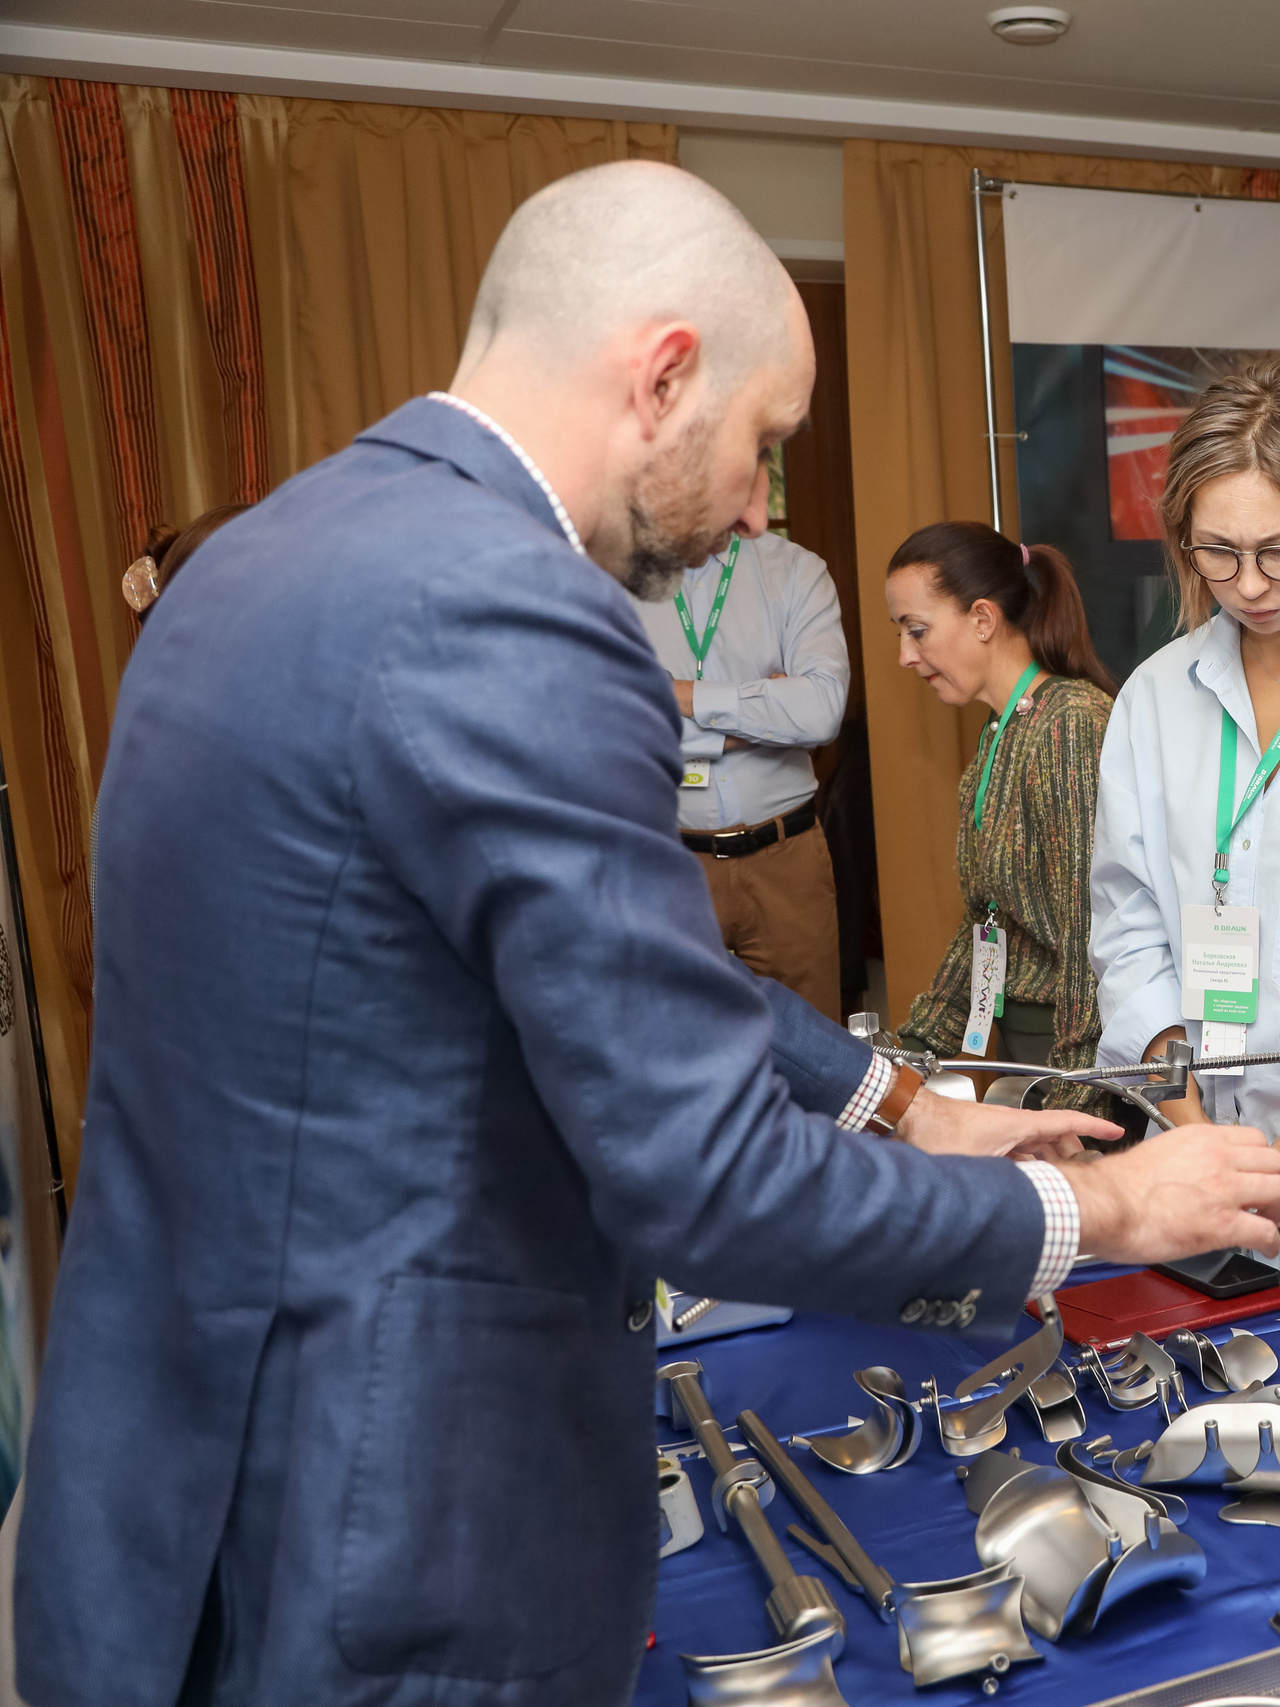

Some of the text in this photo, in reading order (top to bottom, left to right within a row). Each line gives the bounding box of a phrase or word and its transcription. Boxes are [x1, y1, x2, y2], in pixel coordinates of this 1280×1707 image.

[1247, 775, 1263, 800] BRAUN
[1216, 960, 1247, 968] Андреевна
[972, 1035, 979, 1046] 6
